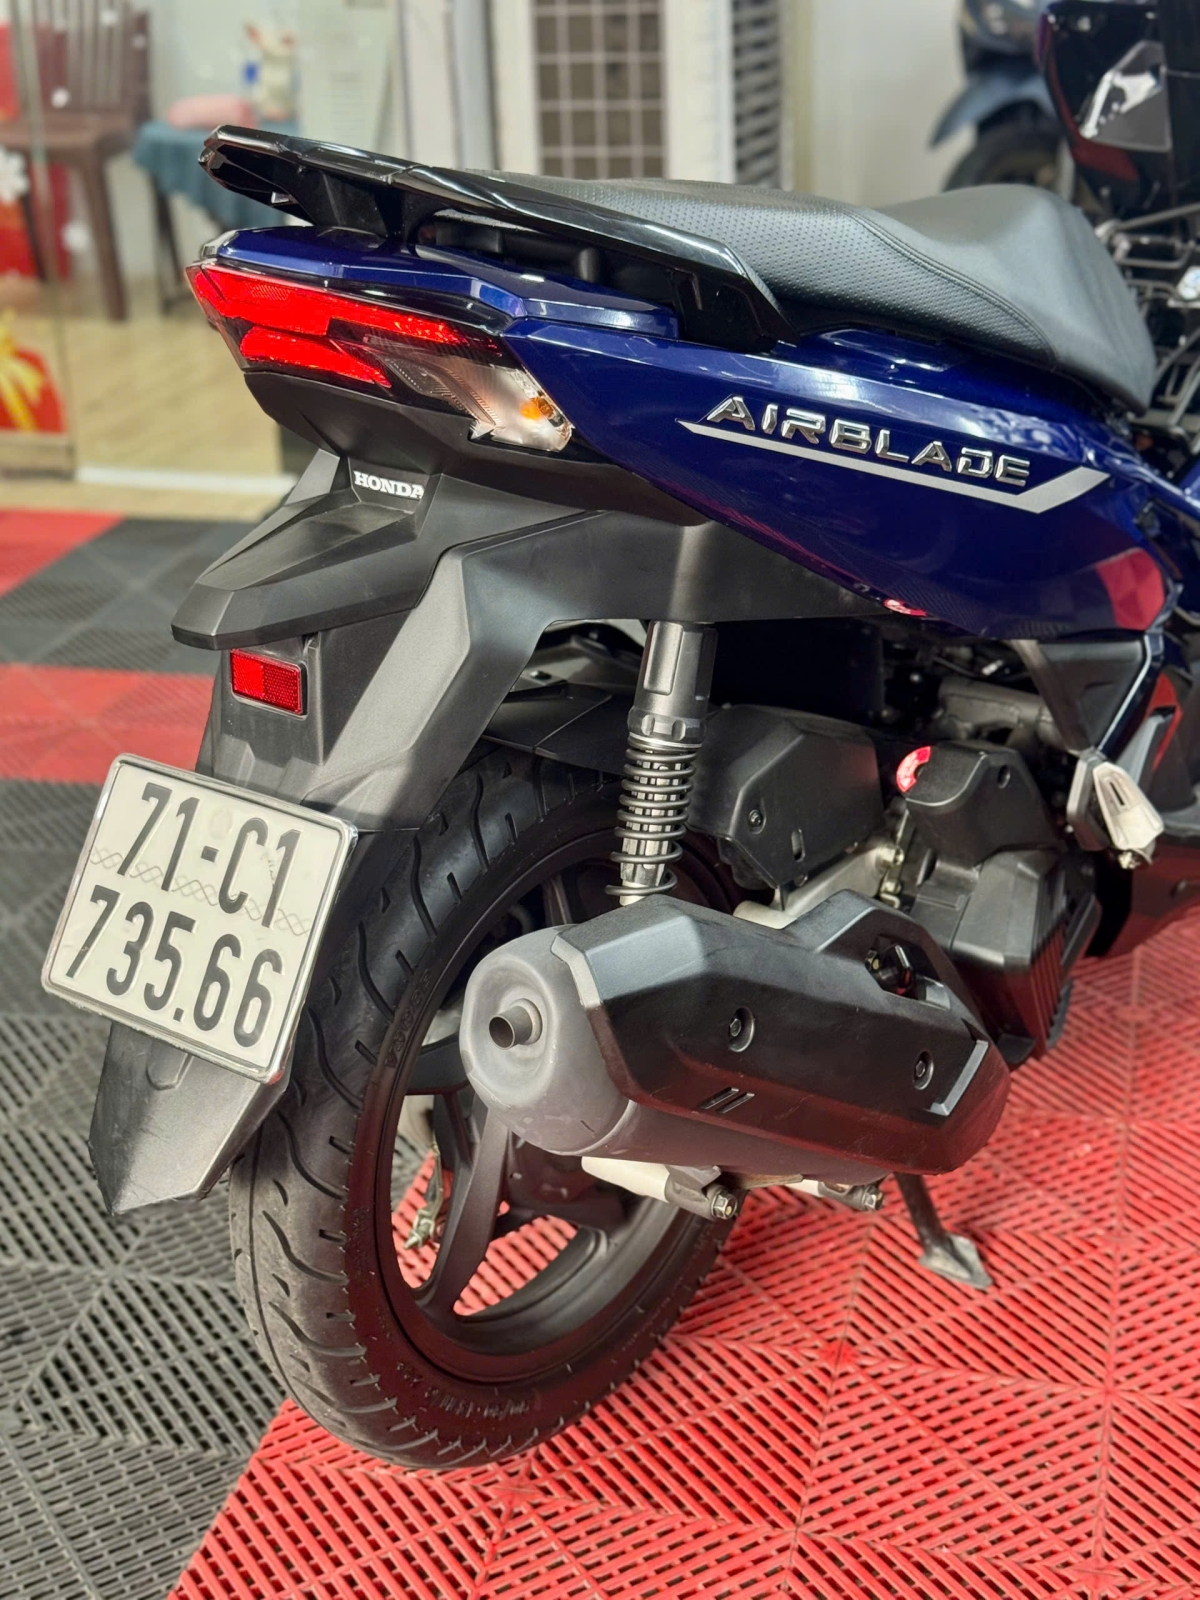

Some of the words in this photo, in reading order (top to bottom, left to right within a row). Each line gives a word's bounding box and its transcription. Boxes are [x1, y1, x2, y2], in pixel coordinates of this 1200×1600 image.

[353, 470, 425, 499] HONDA
[706, 395, 1031, 487] AIRBLADE
[117, 782, 302, 928] 71-C1
[66, 884, 283, 1048] 735.66
